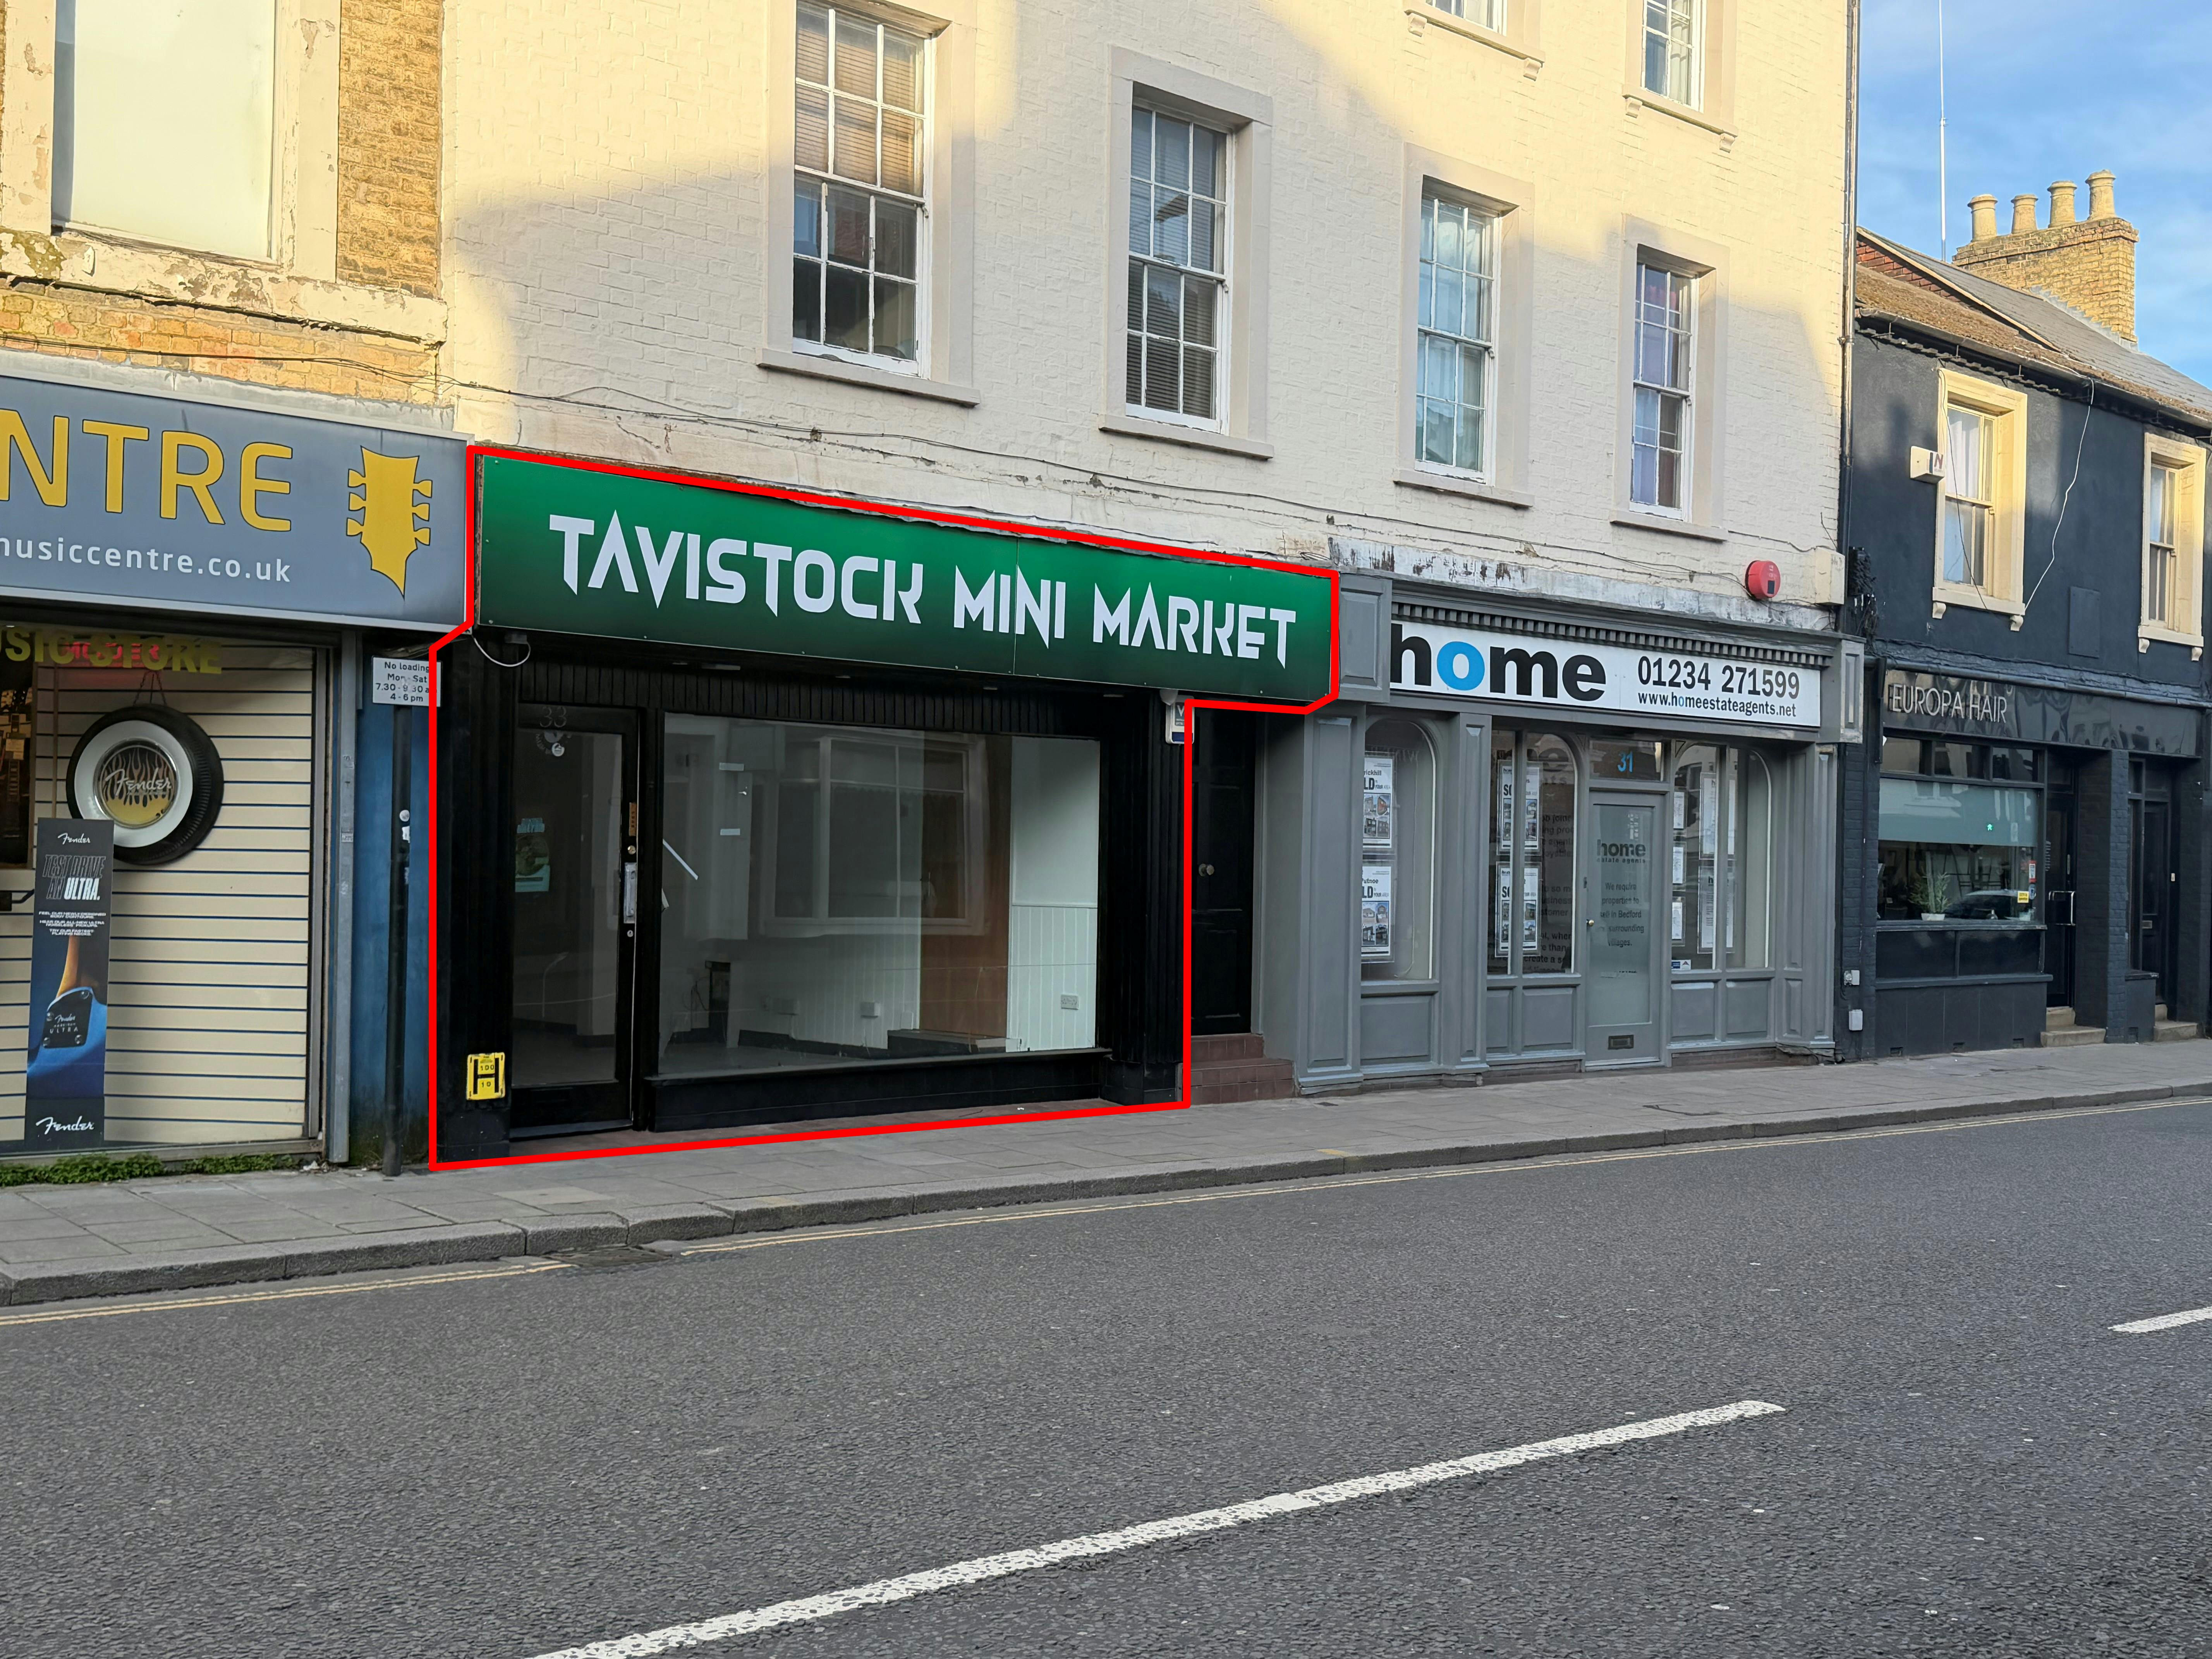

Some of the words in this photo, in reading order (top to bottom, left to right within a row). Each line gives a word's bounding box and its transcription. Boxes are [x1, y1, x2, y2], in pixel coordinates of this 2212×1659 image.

[549, 510, 924, 625] TAVISTOCK
[953, 565, 1066, 648] MINI
[1092, 582, 1296, 669] MARKET
[0, 626, 74, 664] SIC
[88, 634, 222, 674] STORE
[385, 661, 397, 670] No
[400, 662, 429, 673] loading
[1391, 624, 1606, 701] home
[375, 683, 396, 691] 7.30
[403, 684, 423, 693] 930
[1637, 656, 1711, 691] 01234
[1721, 665, 1800, 700] 271599
[1638, 692, 1797, 718] www.homeestateagents.net
[1891, 683, 1964, 719] EUROPA
[1970, 693, 2007, 723] HAIR
[539, 706, 567, 728] 33
[1618, 750, 1633, 773] 31
[105, 767, 172, 797] Fender
[57, 832, 91, 845] Fender
[1597, 839, 1646, 857] home
[42, 854, 72, 878] TEST
[70, 855, 106, 879] DRIVE
[46, 877, 65, 900] AN
[64, 877, 101, 901] ULTRA.
[1616, 883, 1637, 891] require
[1601, 897, 1632, 906] properties
[1618, 910, 1642, 918] Bedford
[1609, 925, 1645, 933] surrounding
[1608, 939, 1632, 948] villages.
[36, 1115, 95, 1136] Fender
